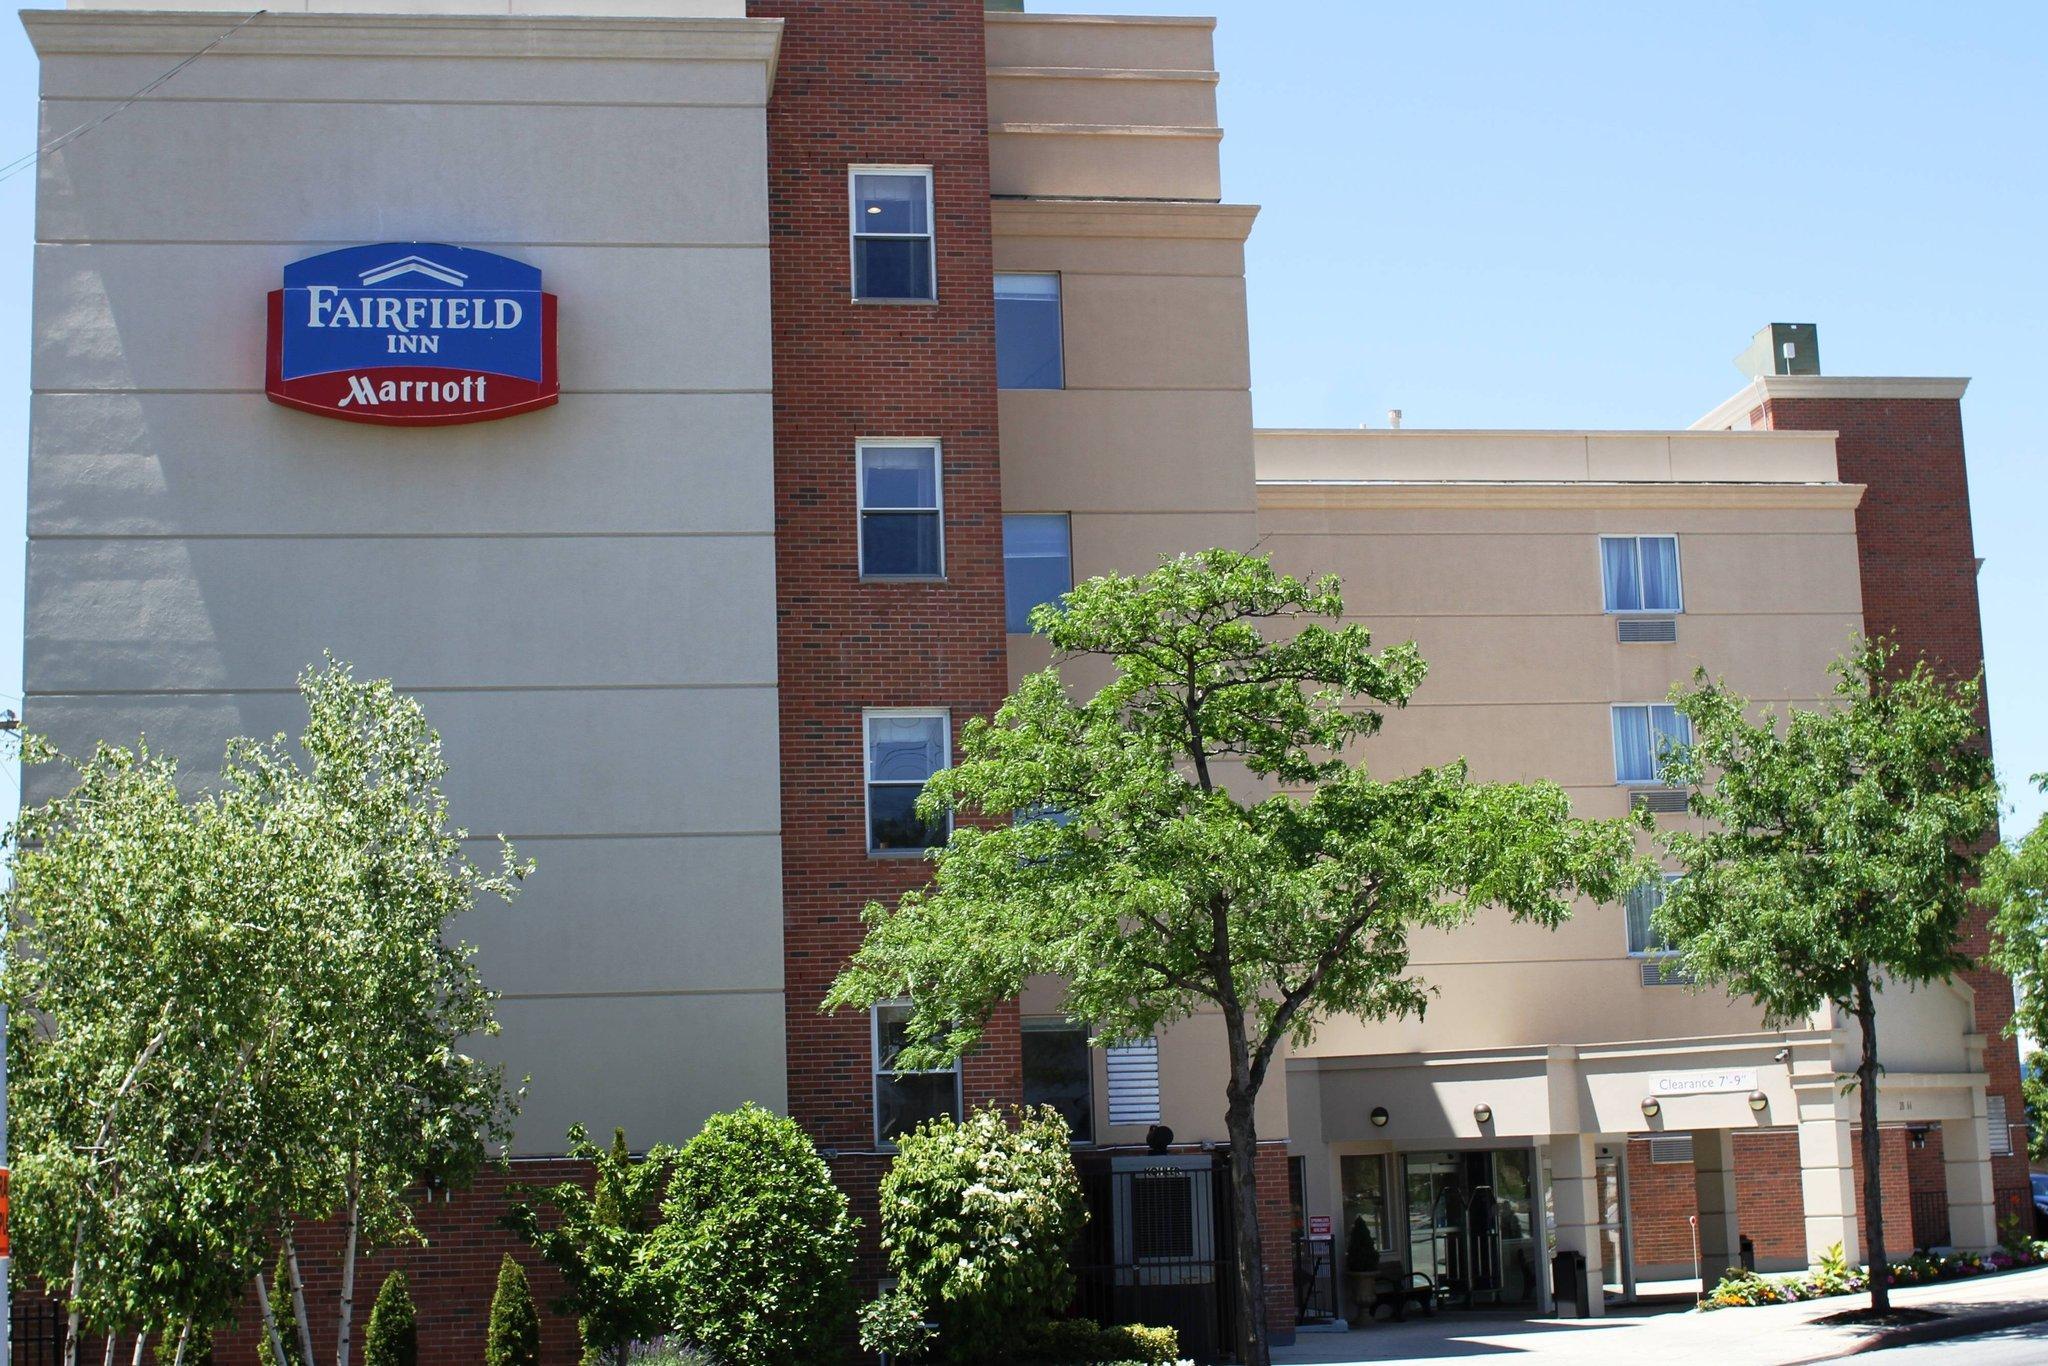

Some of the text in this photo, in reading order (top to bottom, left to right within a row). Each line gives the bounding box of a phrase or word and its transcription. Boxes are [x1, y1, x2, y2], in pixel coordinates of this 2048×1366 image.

[306, 285, 523, 332] FAIRFIELD
[386, 334, 440, 354] INN
[337, 375, 487, 407] Marriott
[1659, 1078, 1715, 1091] Clearance
